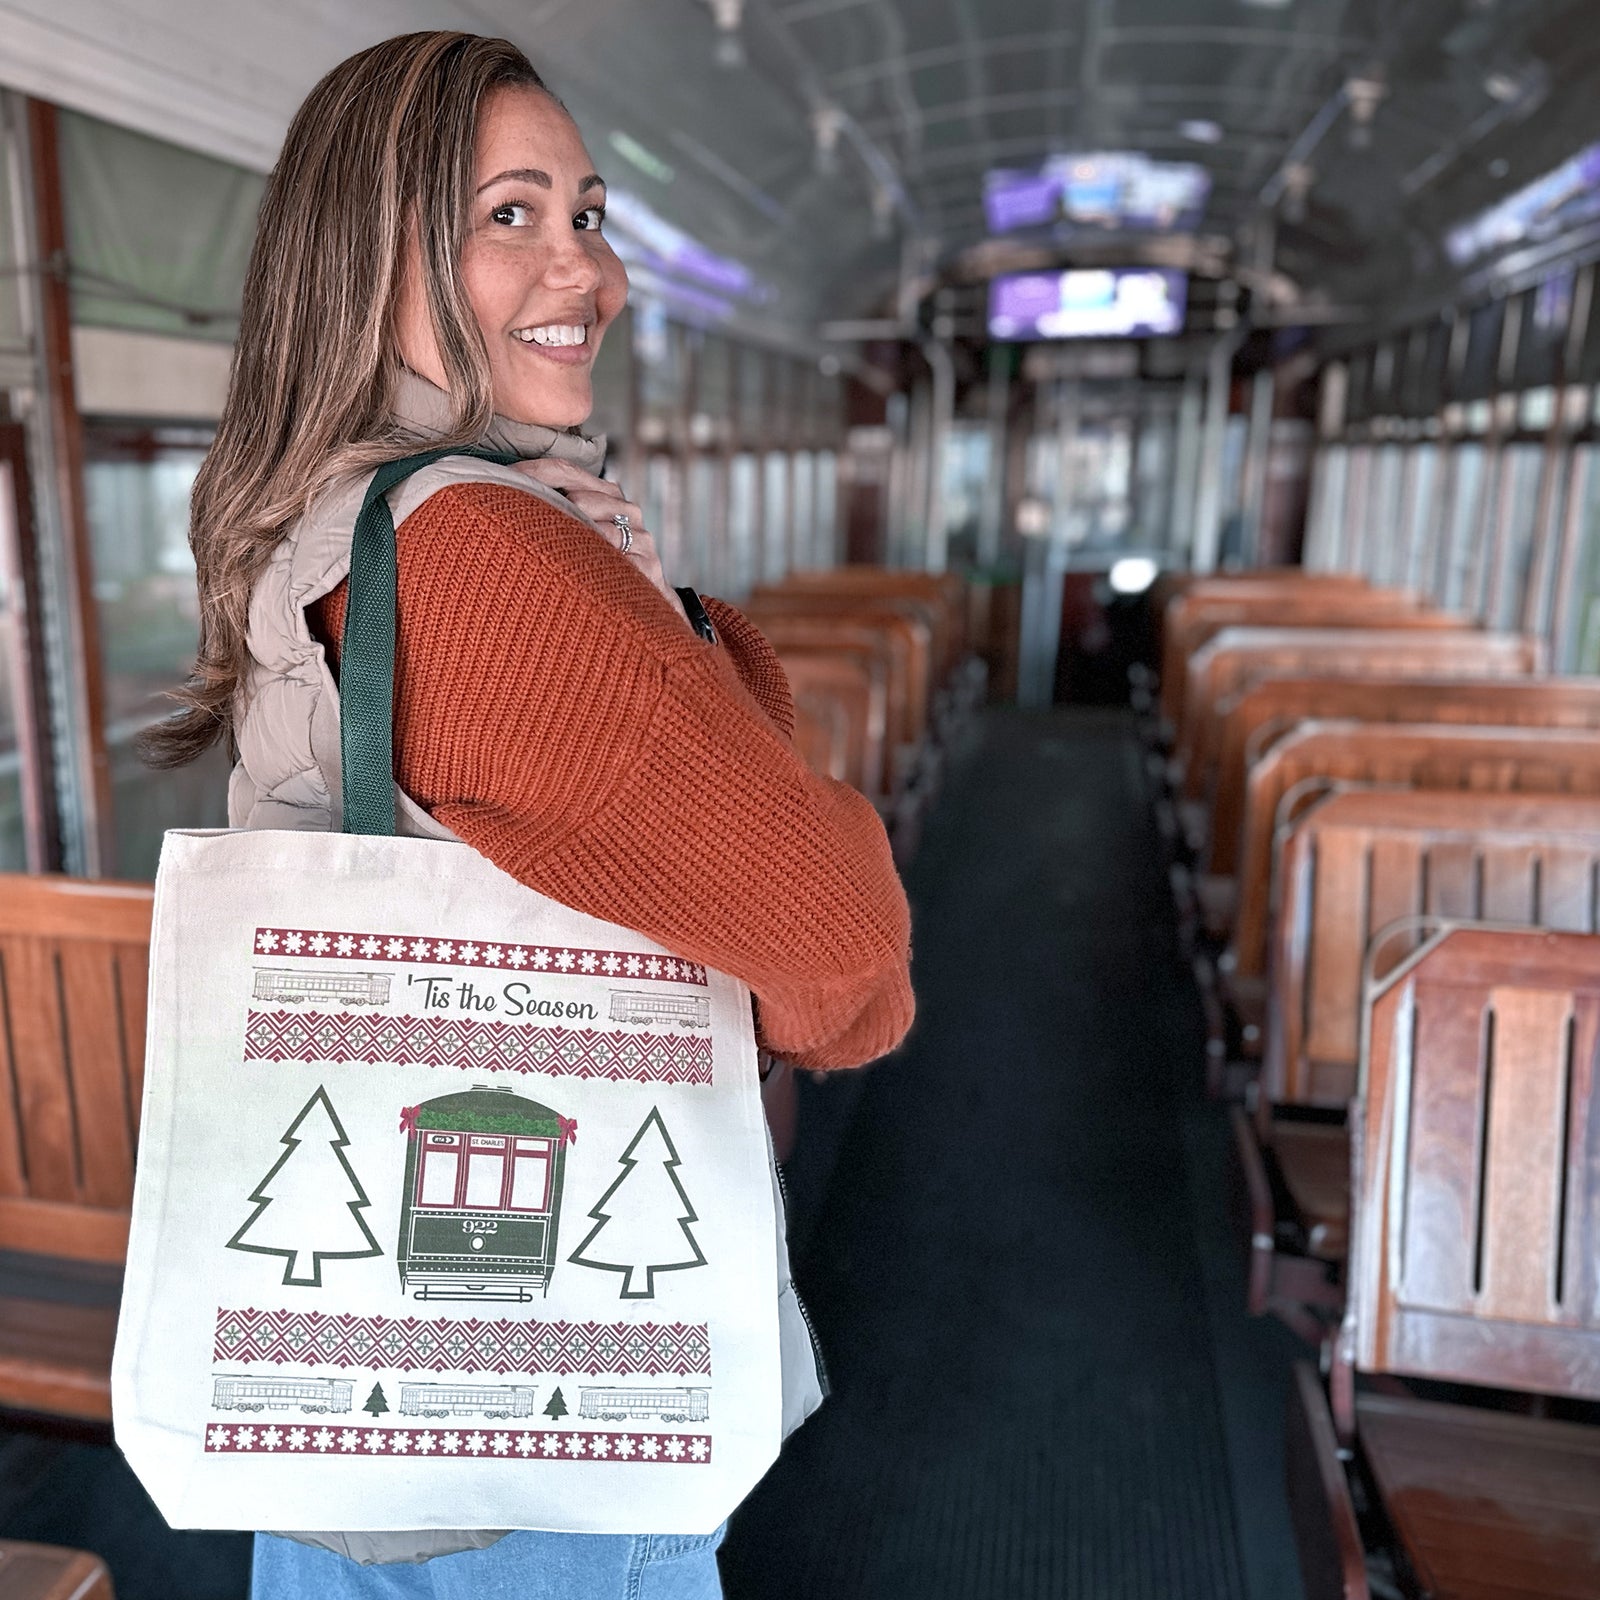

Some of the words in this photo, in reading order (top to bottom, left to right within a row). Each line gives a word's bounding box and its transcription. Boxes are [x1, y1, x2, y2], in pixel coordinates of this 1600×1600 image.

[407, 974, 453, 1009] 'Tis
[456, 983, 497, 1012] the
[503, 982, 599, 1020] Season
[481, 1138, 504, 1147] CHARLES
[462, 1220, 498, 1234] 922
